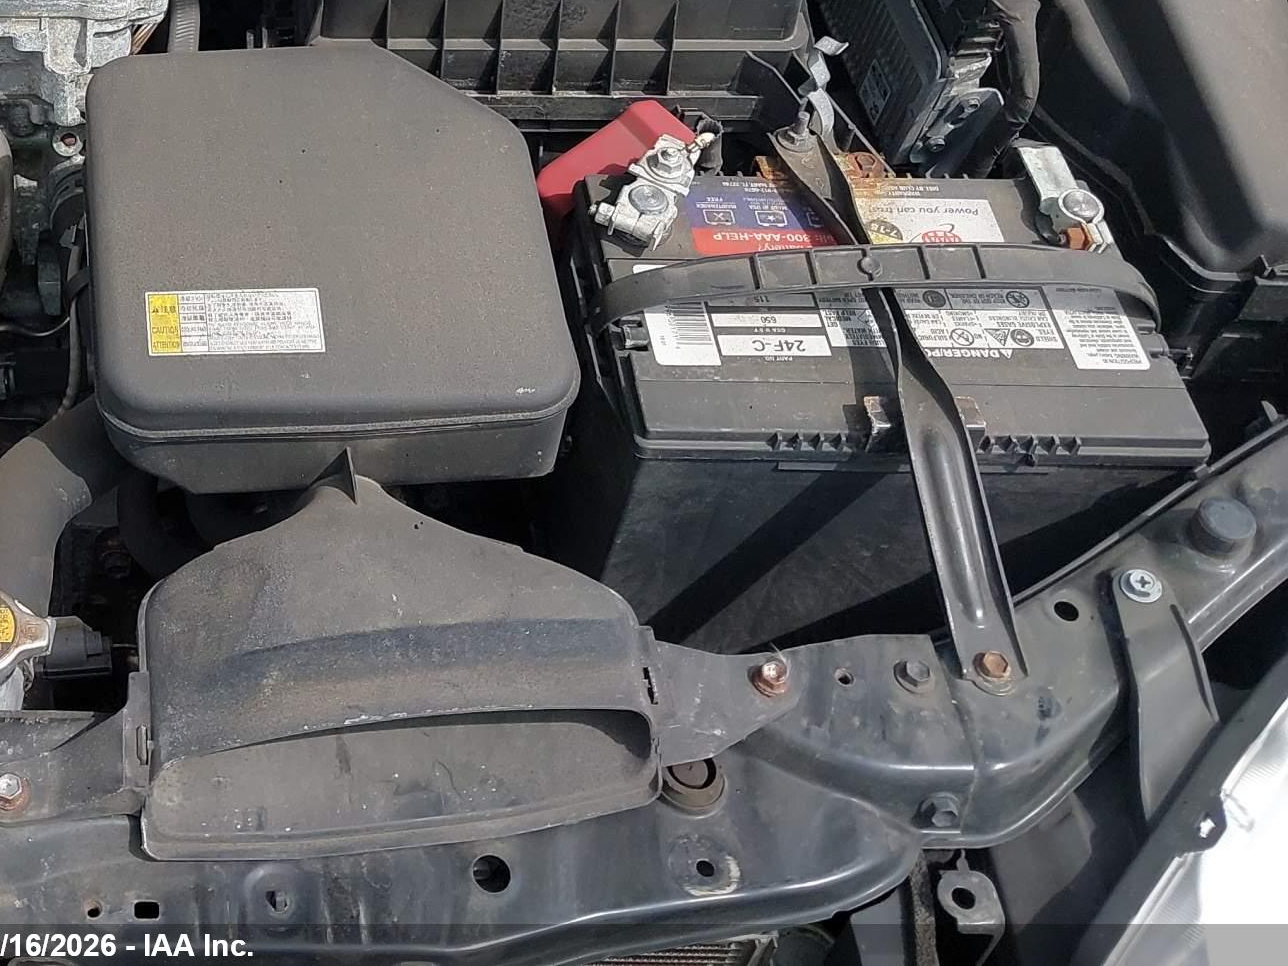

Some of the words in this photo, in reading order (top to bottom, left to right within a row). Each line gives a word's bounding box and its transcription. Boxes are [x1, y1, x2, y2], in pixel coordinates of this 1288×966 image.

[919, 206, 940, 214] you
[944, 207, 979, 216] Power
[760, 315, 777, 324] 650
[751, 339, 806, 352] 24F-C
